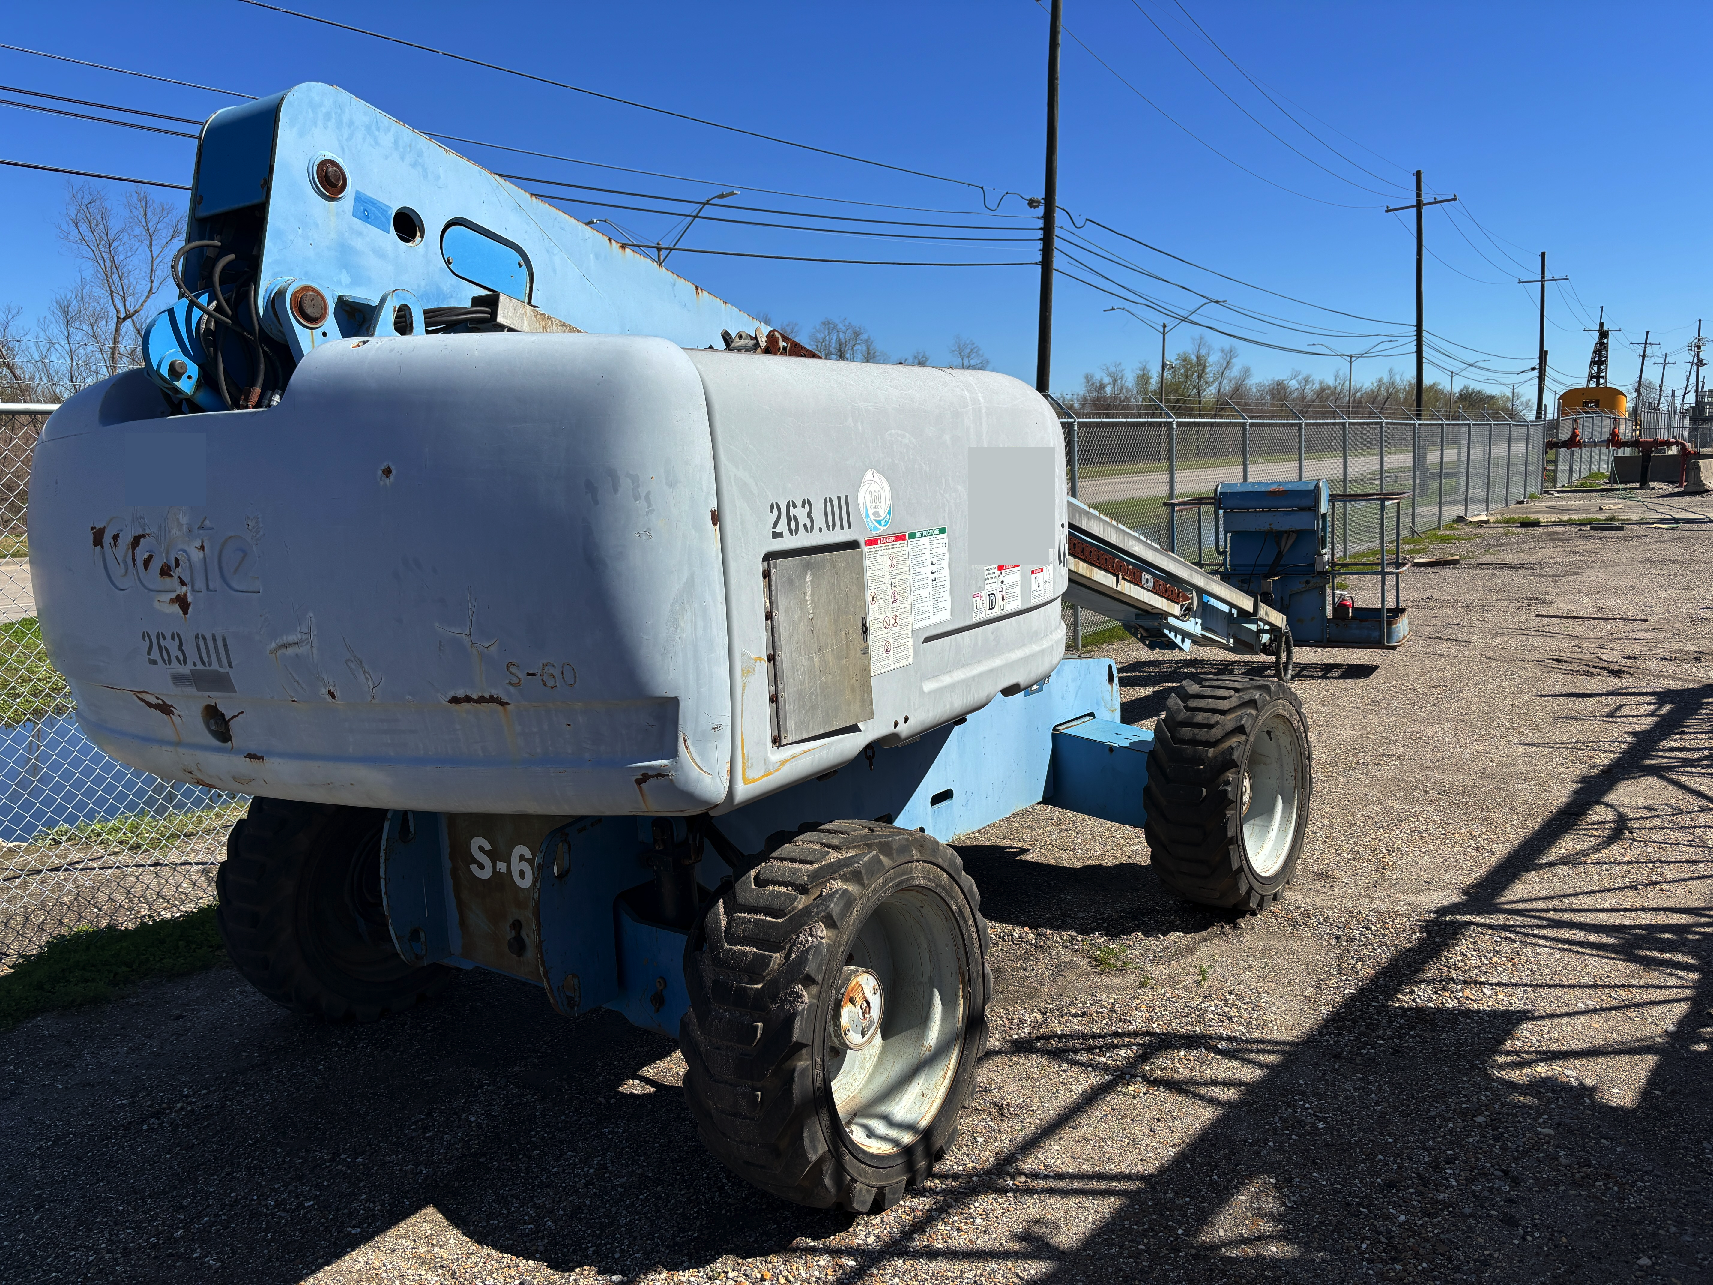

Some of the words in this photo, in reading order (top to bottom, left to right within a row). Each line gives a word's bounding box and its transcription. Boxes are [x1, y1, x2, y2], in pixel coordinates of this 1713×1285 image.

[769, 495, 852, 540] 263.011
[101, 515, 261, 594] Genie
[141, 630, 233, 669] 263.011
[505, 660, 578, 690] S-60
